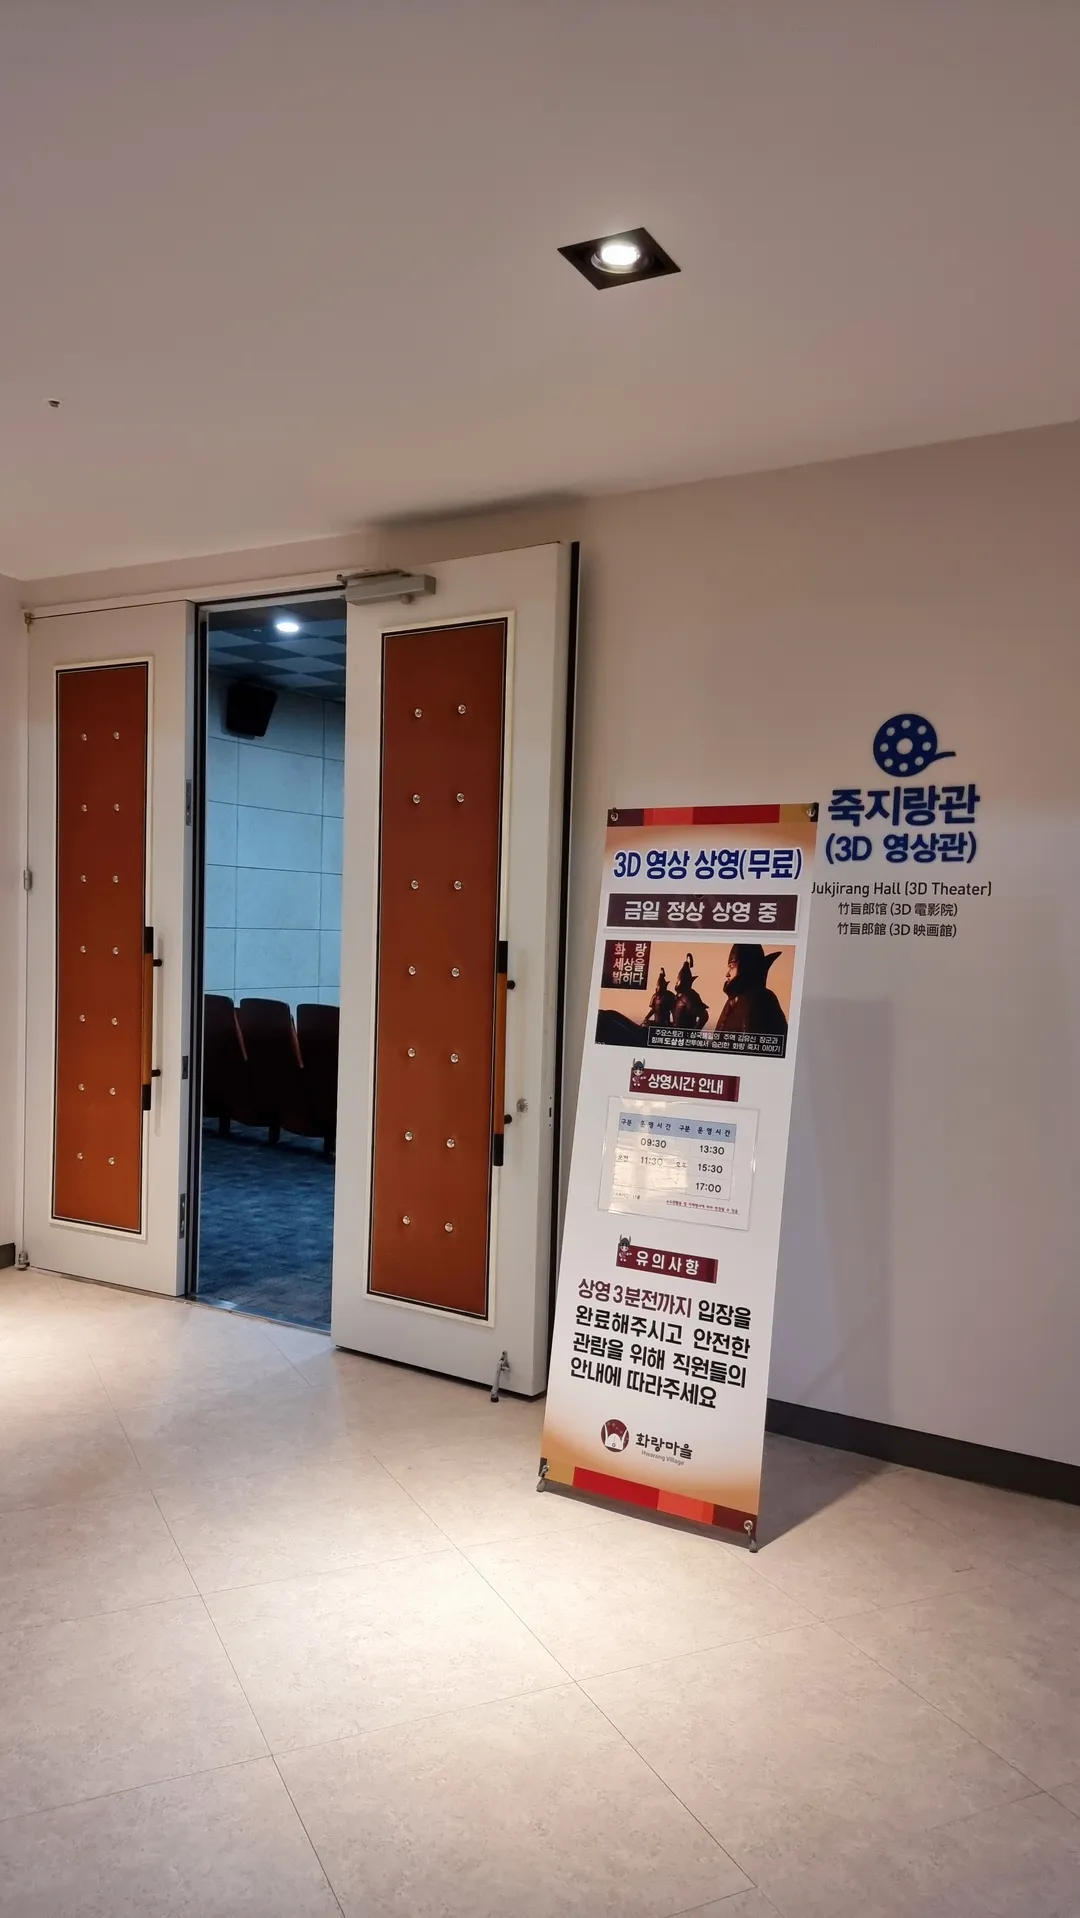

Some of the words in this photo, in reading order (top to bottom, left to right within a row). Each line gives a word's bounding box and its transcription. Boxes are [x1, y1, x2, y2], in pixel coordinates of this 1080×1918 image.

[827, 784, 980, 827] 죽지랑관
[825, 832, 873, 864] (3D
[883, 831, 977, 864] 영상관)
[613, 851, 641, 877] 3D
[646, 850, 690, 880] 영상
[694, 848, 801, 880] 상영(무료)
[811, 882, 869, 897] Jukjirang
[873, 882, 901, 895] Hall
[904, 882, 928, 896] (3D
[931, 881, 992, 897] Theater)
[624, 901, 660, 921] 금일
[667, 901, 705, 922] 정상
[712, 902, 750, 923] 상영
[758, 903, 777, 923] 중
[613, 957, 645, 972] 세상을
[612, 971, 644, 986] 밝히다
[648, 1073, 696, 1092] 상영시간
[699, 1078, 723, 1094] 안내
[640, 1138, 667, 1148] 09:30
[699, 1145, 725, 1156] 13:30
[640, 1156, 663, 1166] 11:30
[698, 1163, 723, 1174] 15:30
[695, 1182, 722, 1193] 17:00
[698, 1300, 752, 1330] 입장을
[575, 1305, 683, 1345] 완료해주시고
[693, 1328, 751, 1359] 안전한
[573, 1332, 624, 1361] 관람을
[629, 1344, 665, 1370] 위해
[672, 1352, 747, 1389] 직원들의
[570, 1357, 622, 1387] 안내에
[627, 1370, 717, 1409] 따라주세요
[635, 1433, 693, 1460] 화랑마을
[641, 1450, 666, 1462] Hwarang
[666, 1456, 685, 1466] Village
